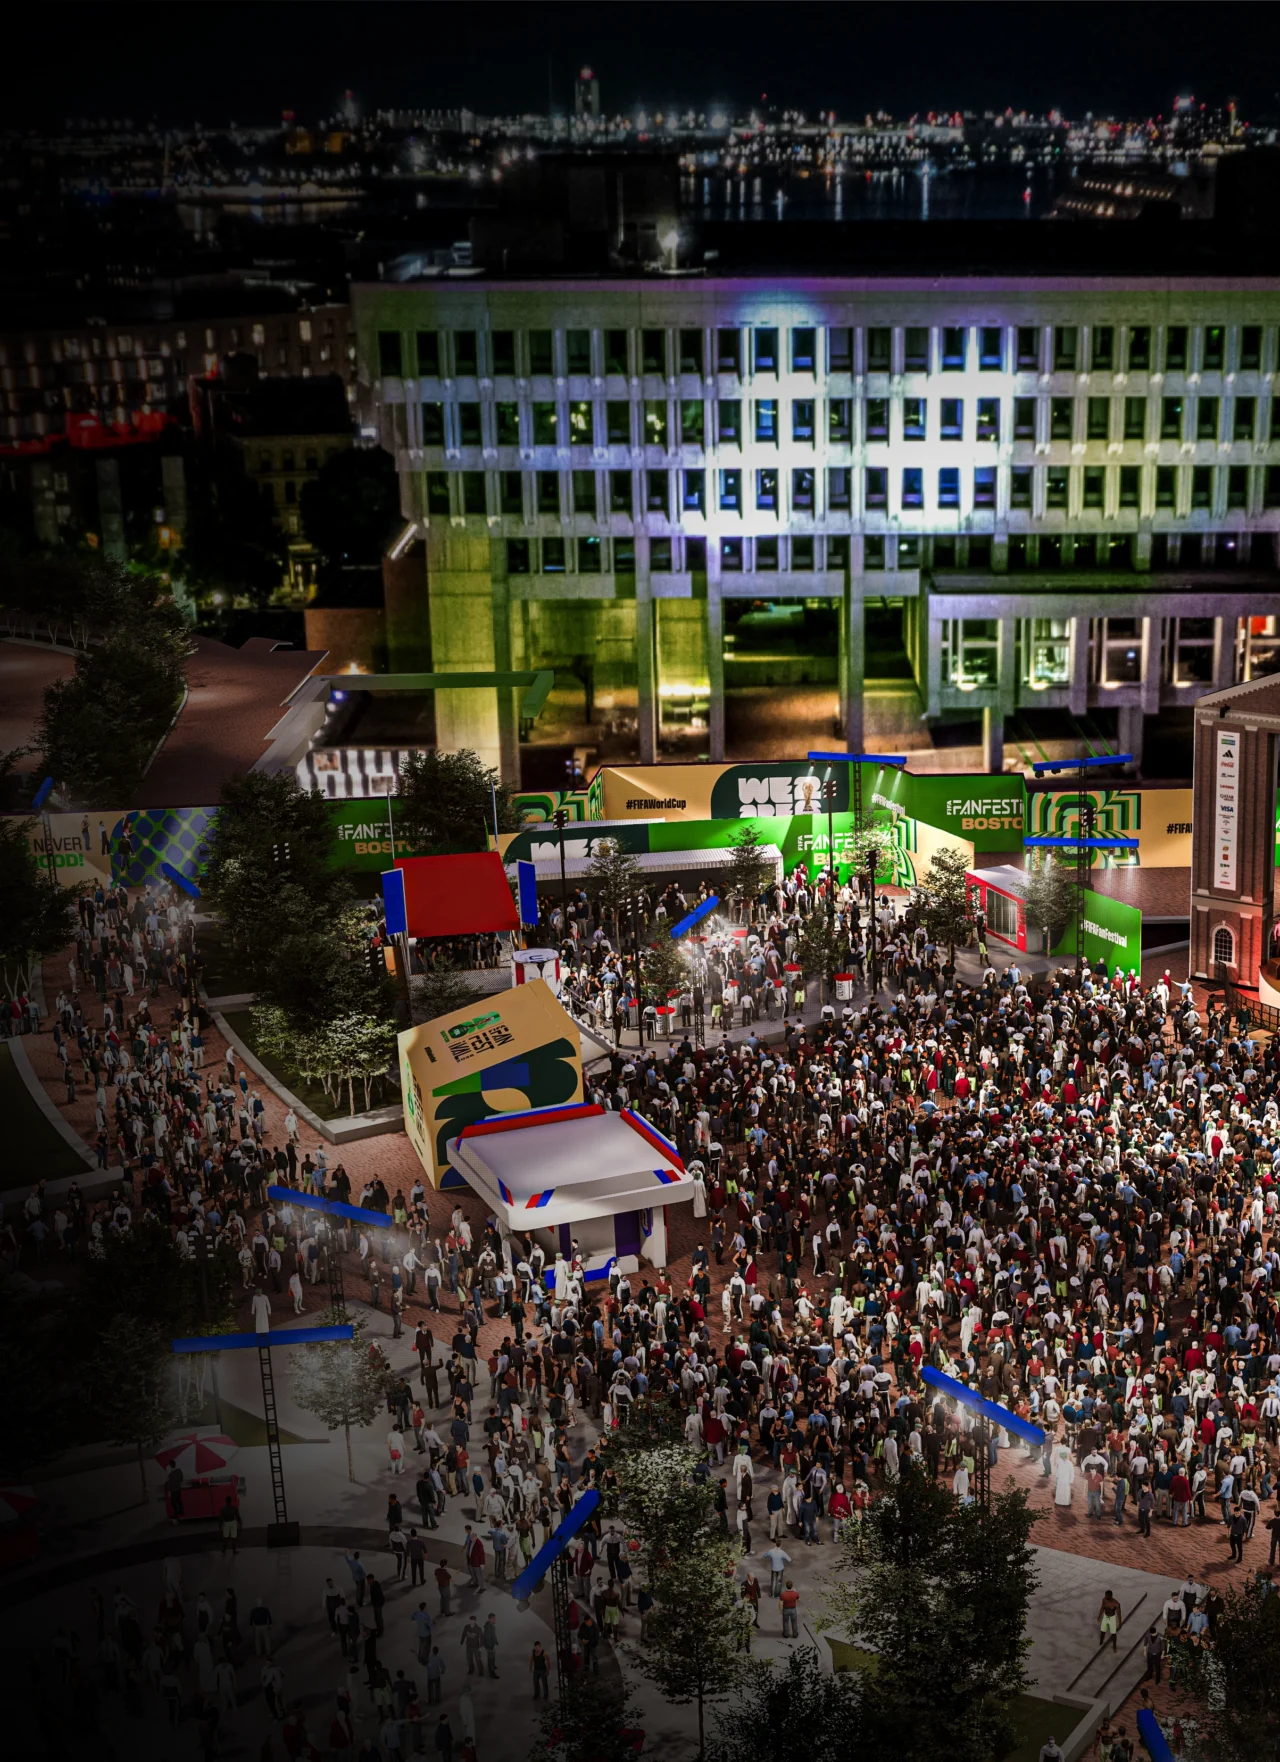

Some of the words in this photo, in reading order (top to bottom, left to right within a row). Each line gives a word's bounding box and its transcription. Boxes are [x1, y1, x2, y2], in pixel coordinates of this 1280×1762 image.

[626, 798, 687, 811] #FIFAWorldCup
[1220, 805, 1233, 813] VISA
[962, 817, 1024, 830] BOSTO
[1167, 823, 1192, 834] #FIFA
[33, 837, 82, 852] NVER
[355, 840, 432, 854] BOSTO
